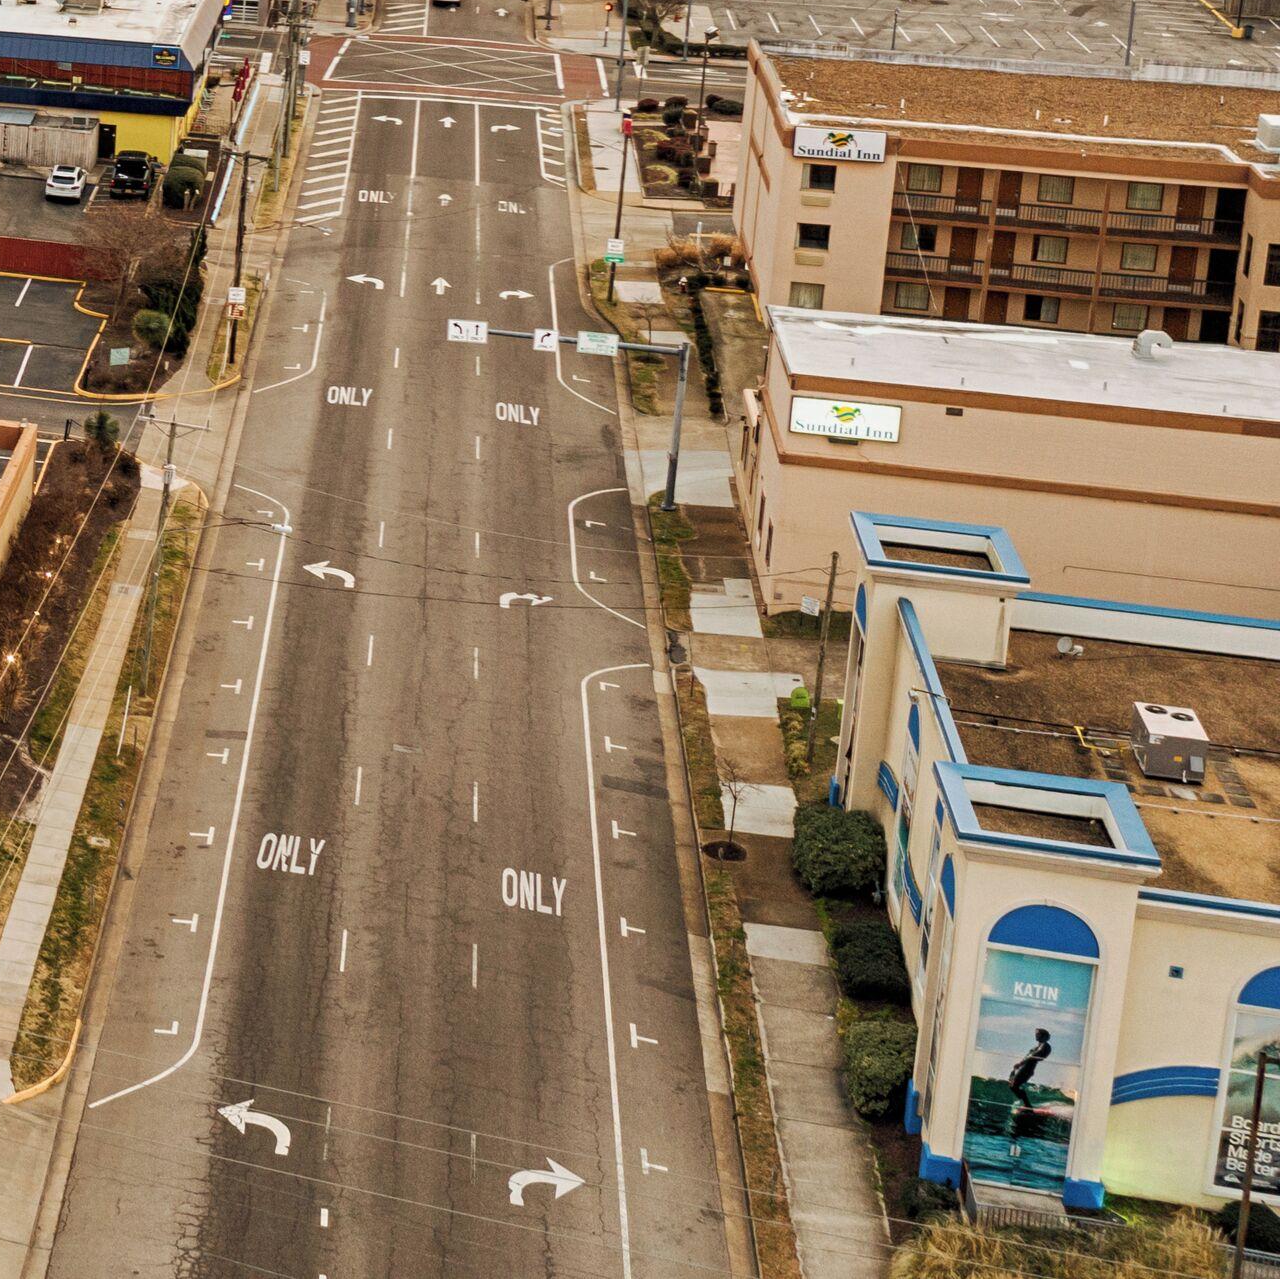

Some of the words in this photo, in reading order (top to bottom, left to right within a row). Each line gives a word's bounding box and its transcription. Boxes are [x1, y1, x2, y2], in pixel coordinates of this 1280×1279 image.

[797, 145, 852, 158] Sundial
[857, 149, 880, 160] Inn
[327, 386, 372, 407] ONLY
[495, 402, 540, 426] ONLY
[795, 420, 858, 436] Sundial
[866, 426, 893, 439] Inn
[256, 832, 325, 875] ONLY
[502, 868, 567, 916] ONLY
[1014, 981, 1059, 1001] KATIN
